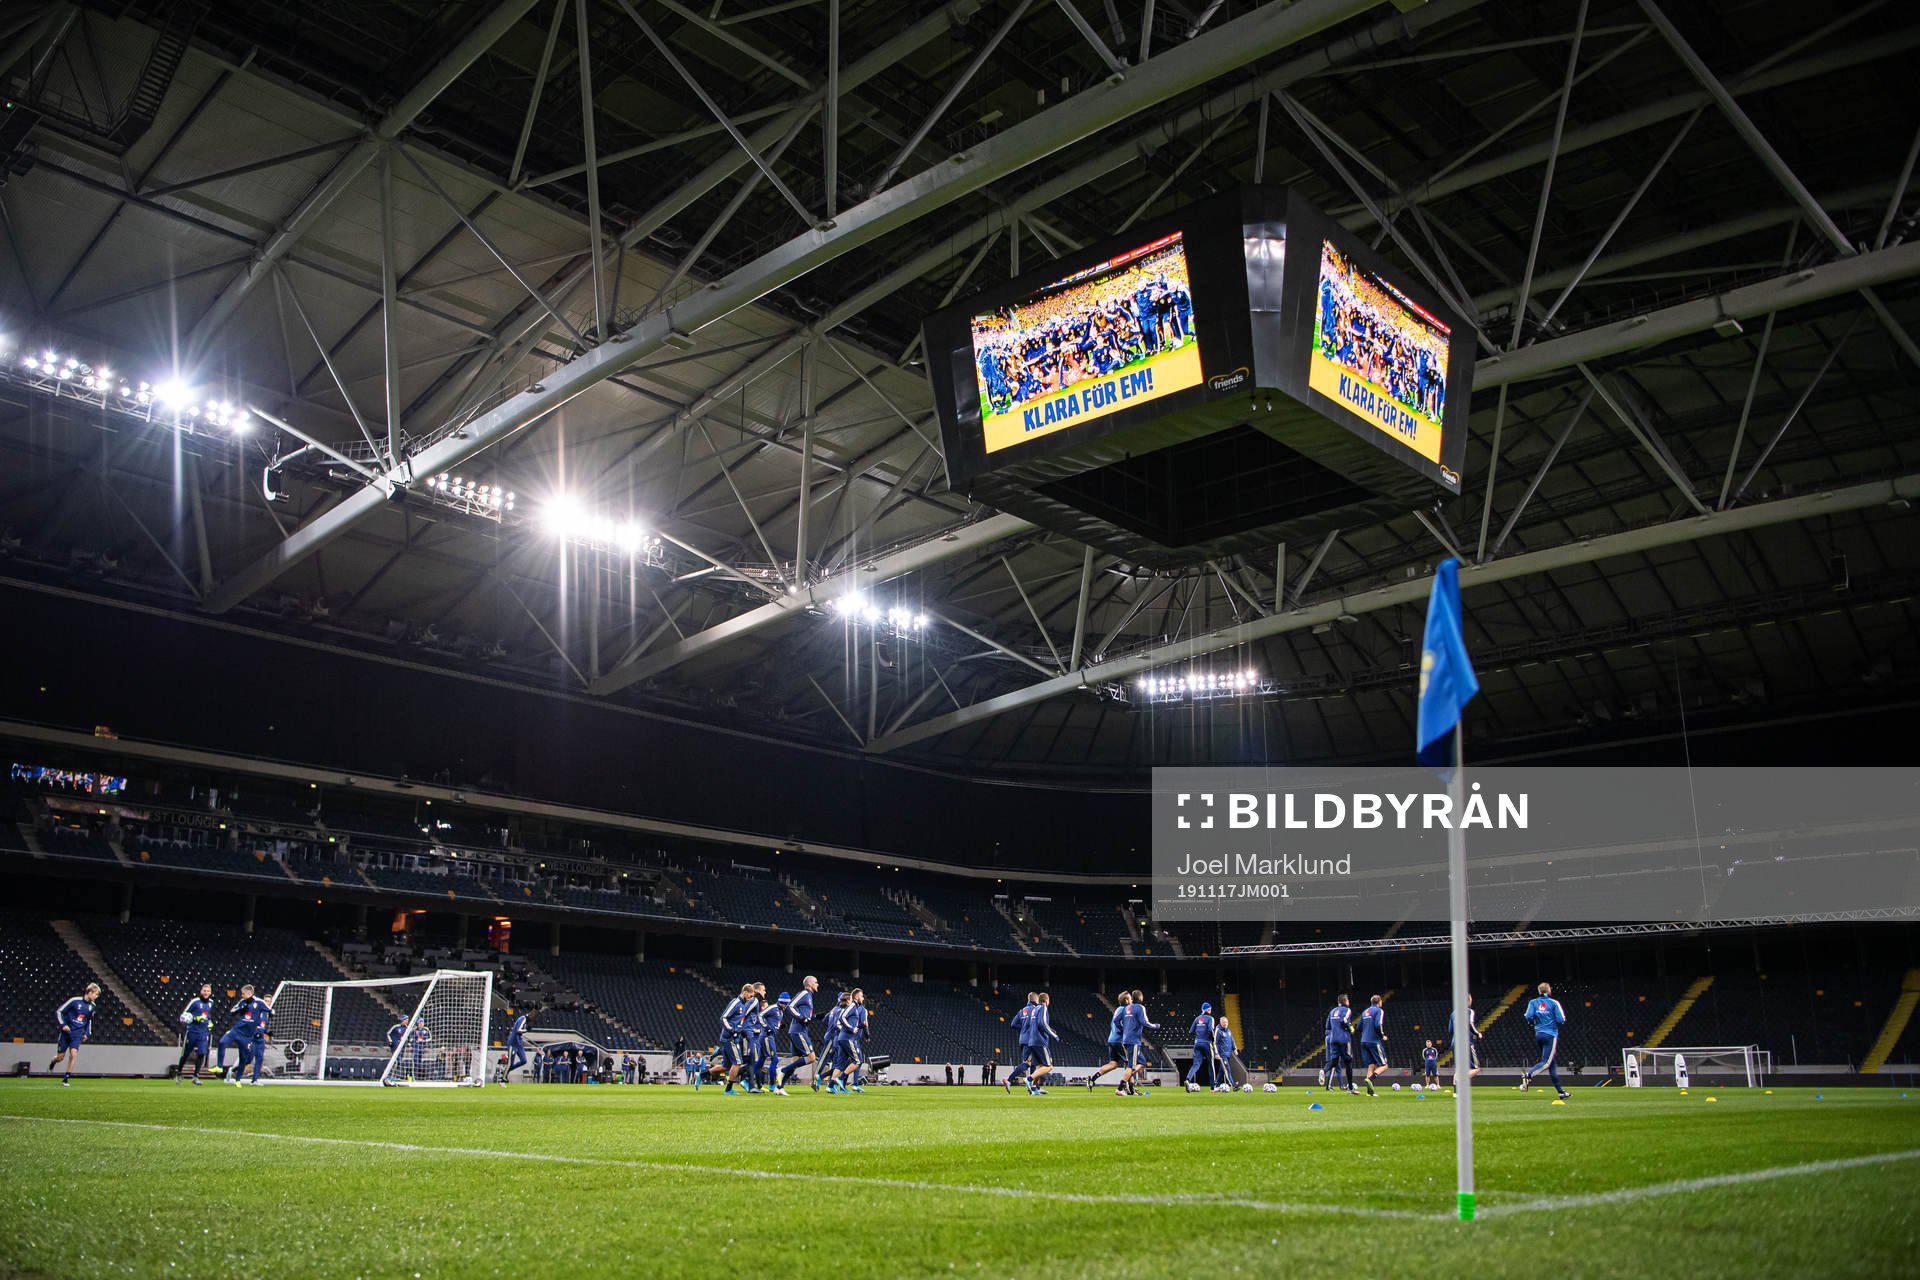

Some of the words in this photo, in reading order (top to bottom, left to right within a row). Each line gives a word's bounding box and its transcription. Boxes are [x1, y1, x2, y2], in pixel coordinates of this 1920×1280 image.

[1023, 394, 1080, 432] KLARA
[1082, 381, 1117, 412] FÖR
[1120, 368, 1153, 399] EM!
[1214, 374, 1244, 390] friends
[1339, 373, 1375, 415] KLARA
[1376, 397, 1397, 428] FÖR
[1399, 411, 1417, 441] EM!
